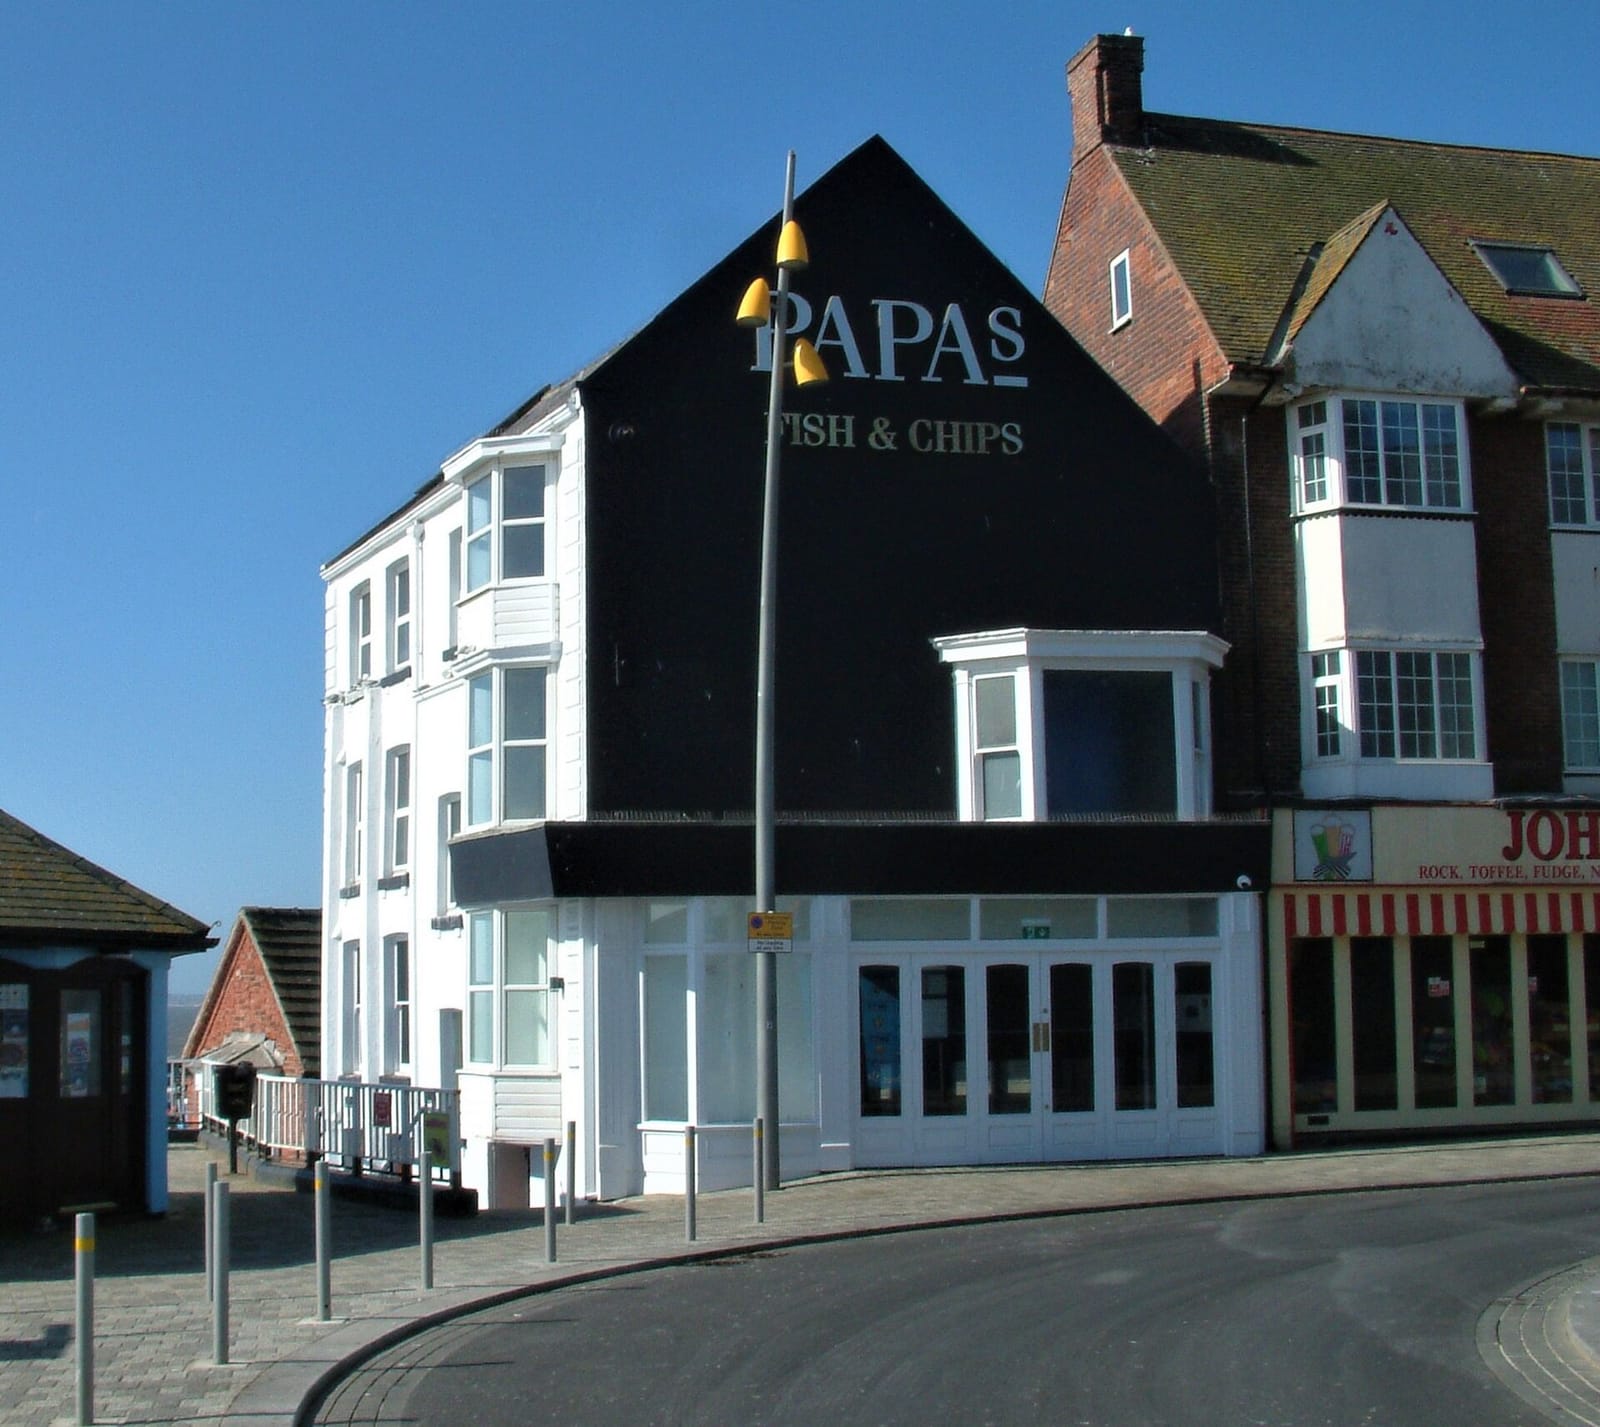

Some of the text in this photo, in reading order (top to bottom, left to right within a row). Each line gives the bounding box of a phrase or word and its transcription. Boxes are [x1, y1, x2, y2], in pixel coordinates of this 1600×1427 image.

[750, 290, 1027, 386] PAPAS
[868, 416, 898, 450] &
[908, 418, 1024, 455] CHIPS
[1502, 809, 1600, 861] JOH
[1533, 864, 1585, 881] FUDGE,
